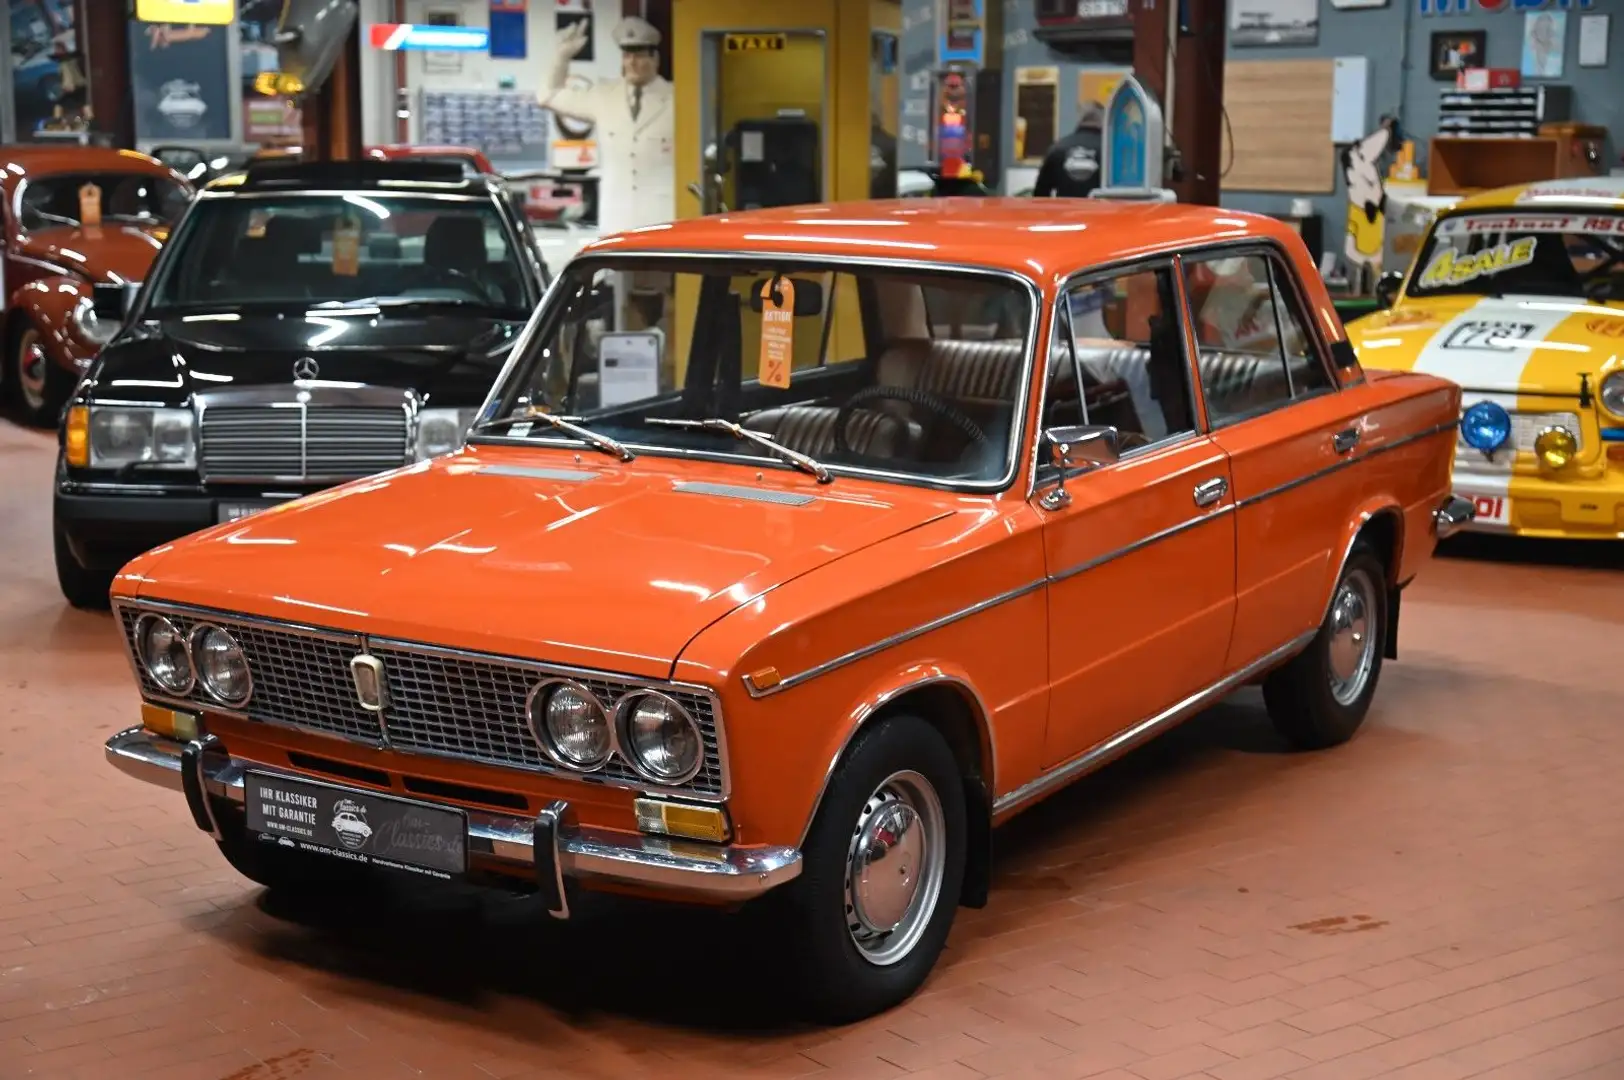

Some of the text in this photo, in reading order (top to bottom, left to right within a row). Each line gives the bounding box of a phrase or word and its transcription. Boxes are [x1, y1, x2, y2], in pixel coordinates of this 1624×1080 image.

[260, 786, 318, 809] IHR KLASSIKER
[262, 803, 317, 826] MIT GARANTIE
[300, 842, 368, 863] www.om-classics.de
